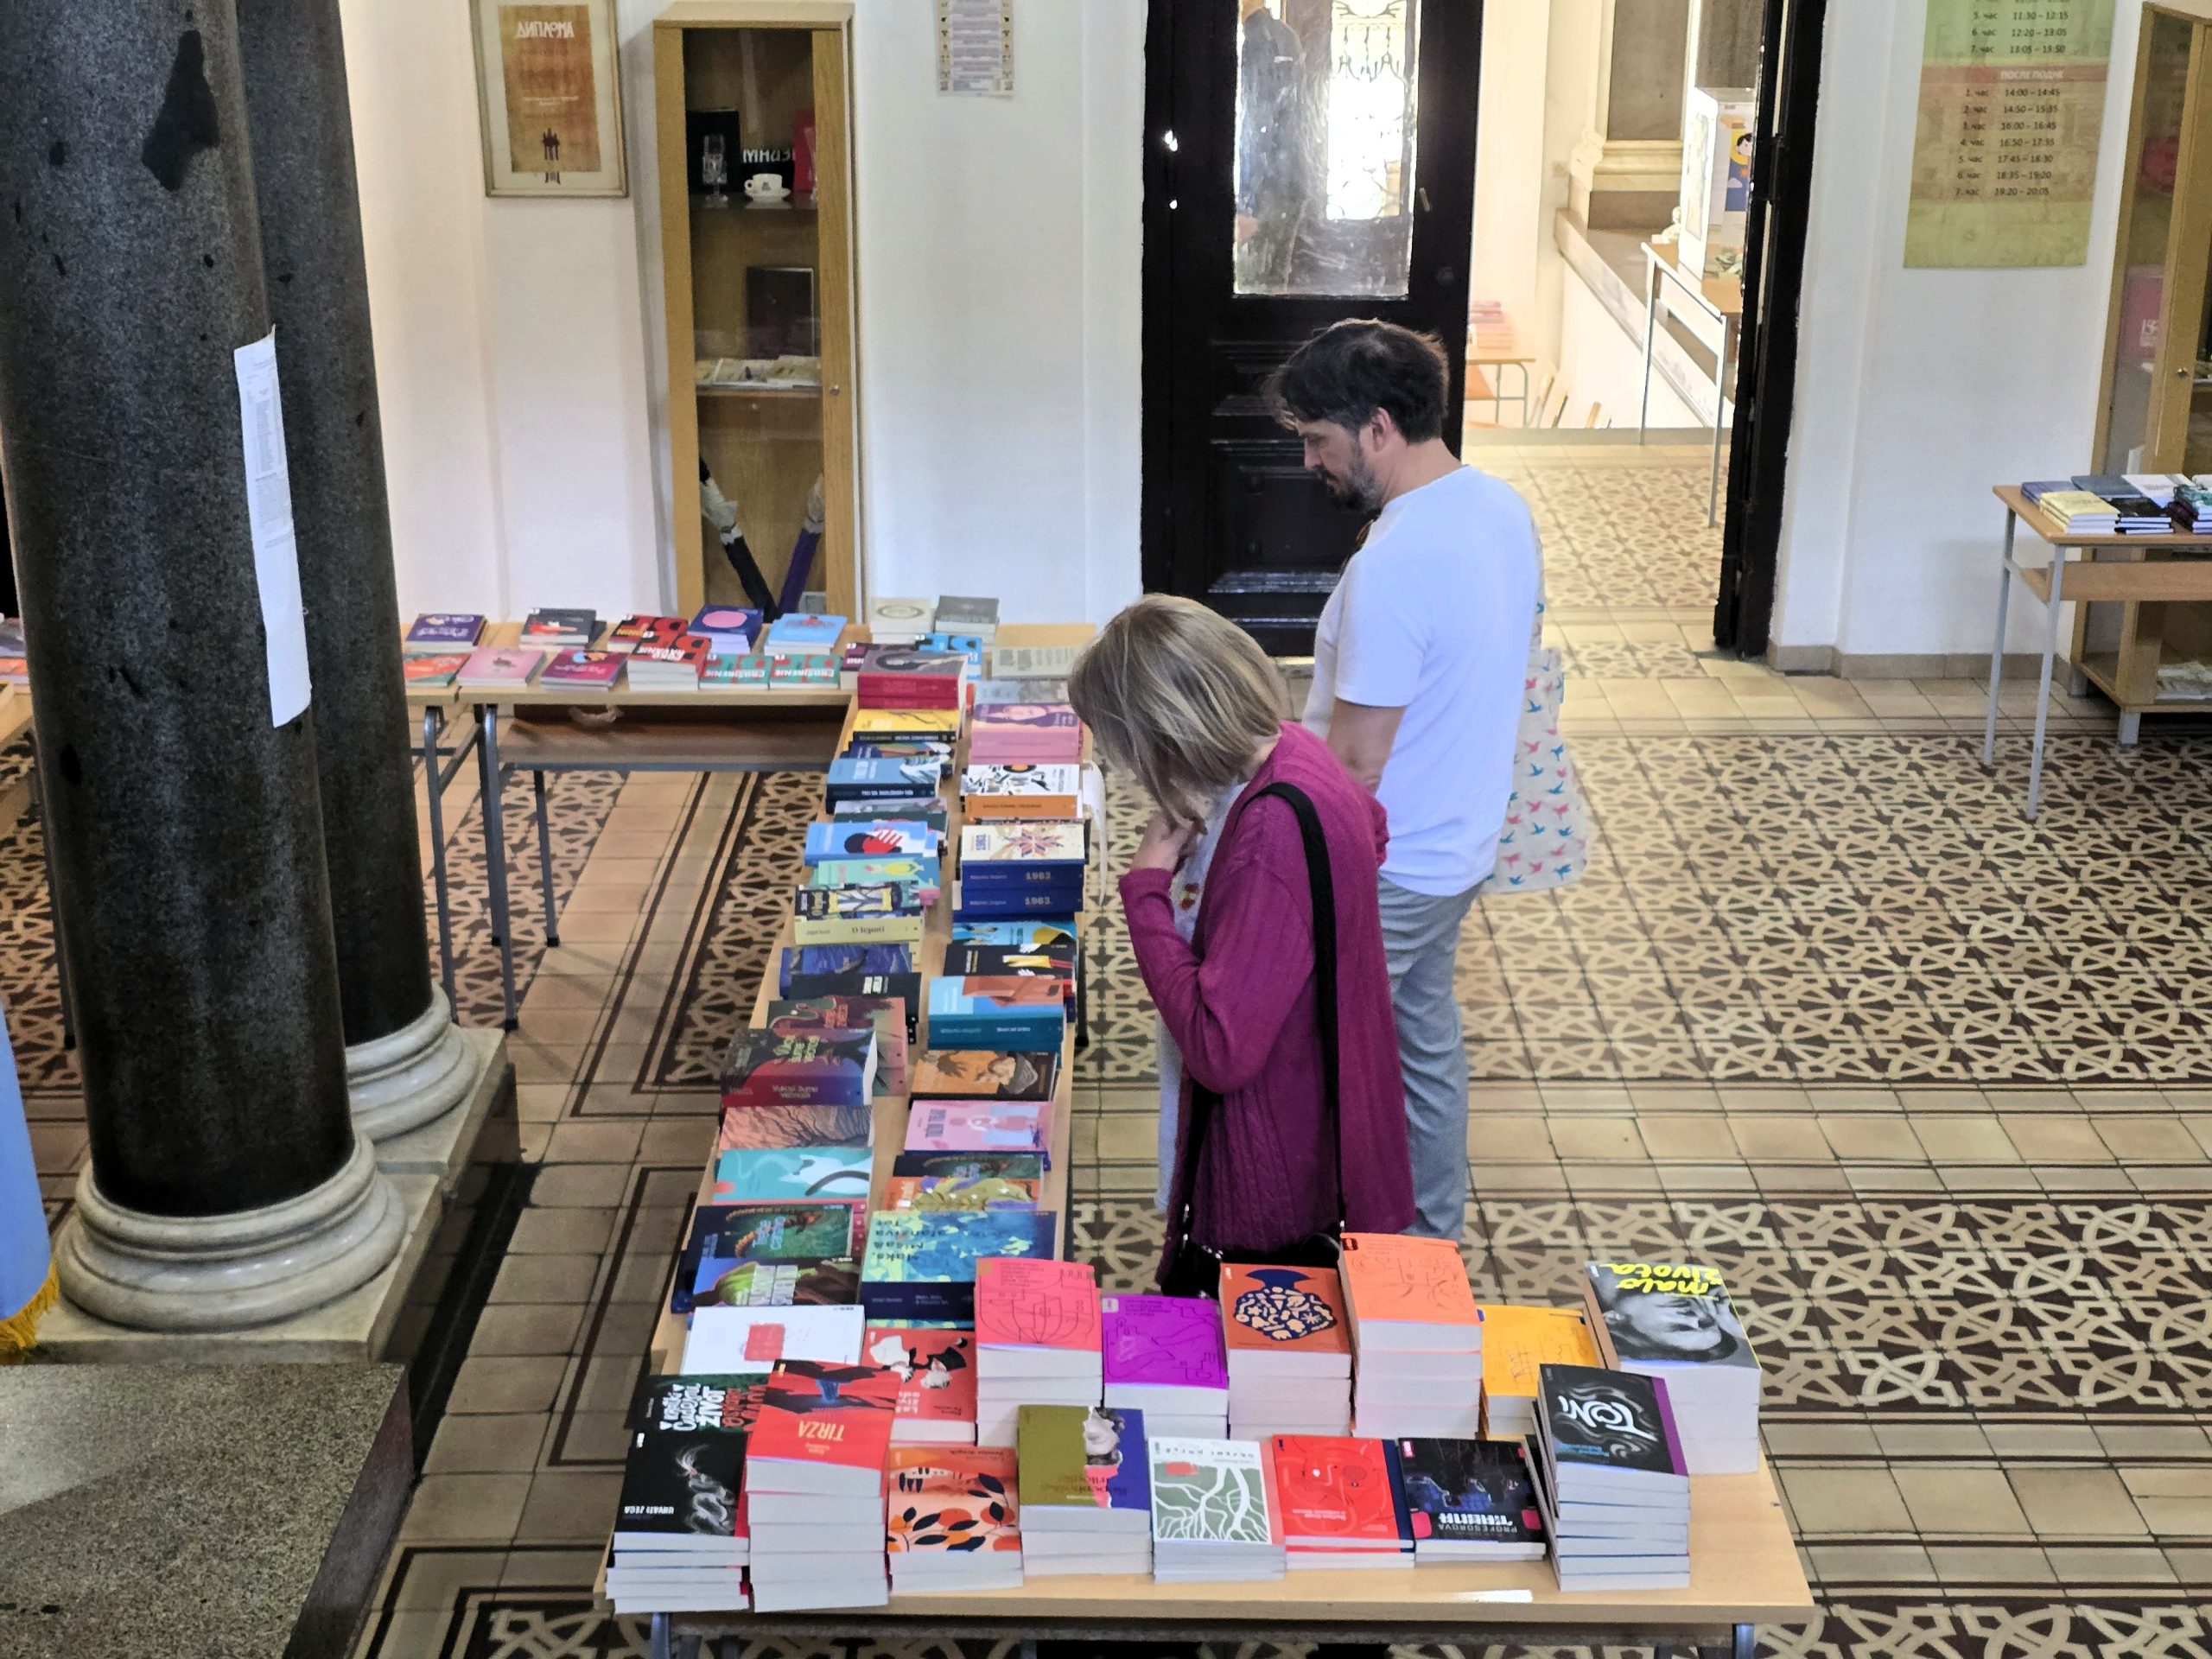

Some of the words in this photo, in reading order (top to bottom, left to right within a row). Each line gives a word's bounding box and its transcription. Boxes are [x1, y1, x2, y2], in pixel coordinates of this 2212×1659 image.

[516, 21, 575, 39] ДИПЛОМА
[1616, 1278, 1708, 1294] malo
[798, 1421, 845, 1442] TIRZA
[1438, 1523, 1518, 1534] PROFESOROVA
